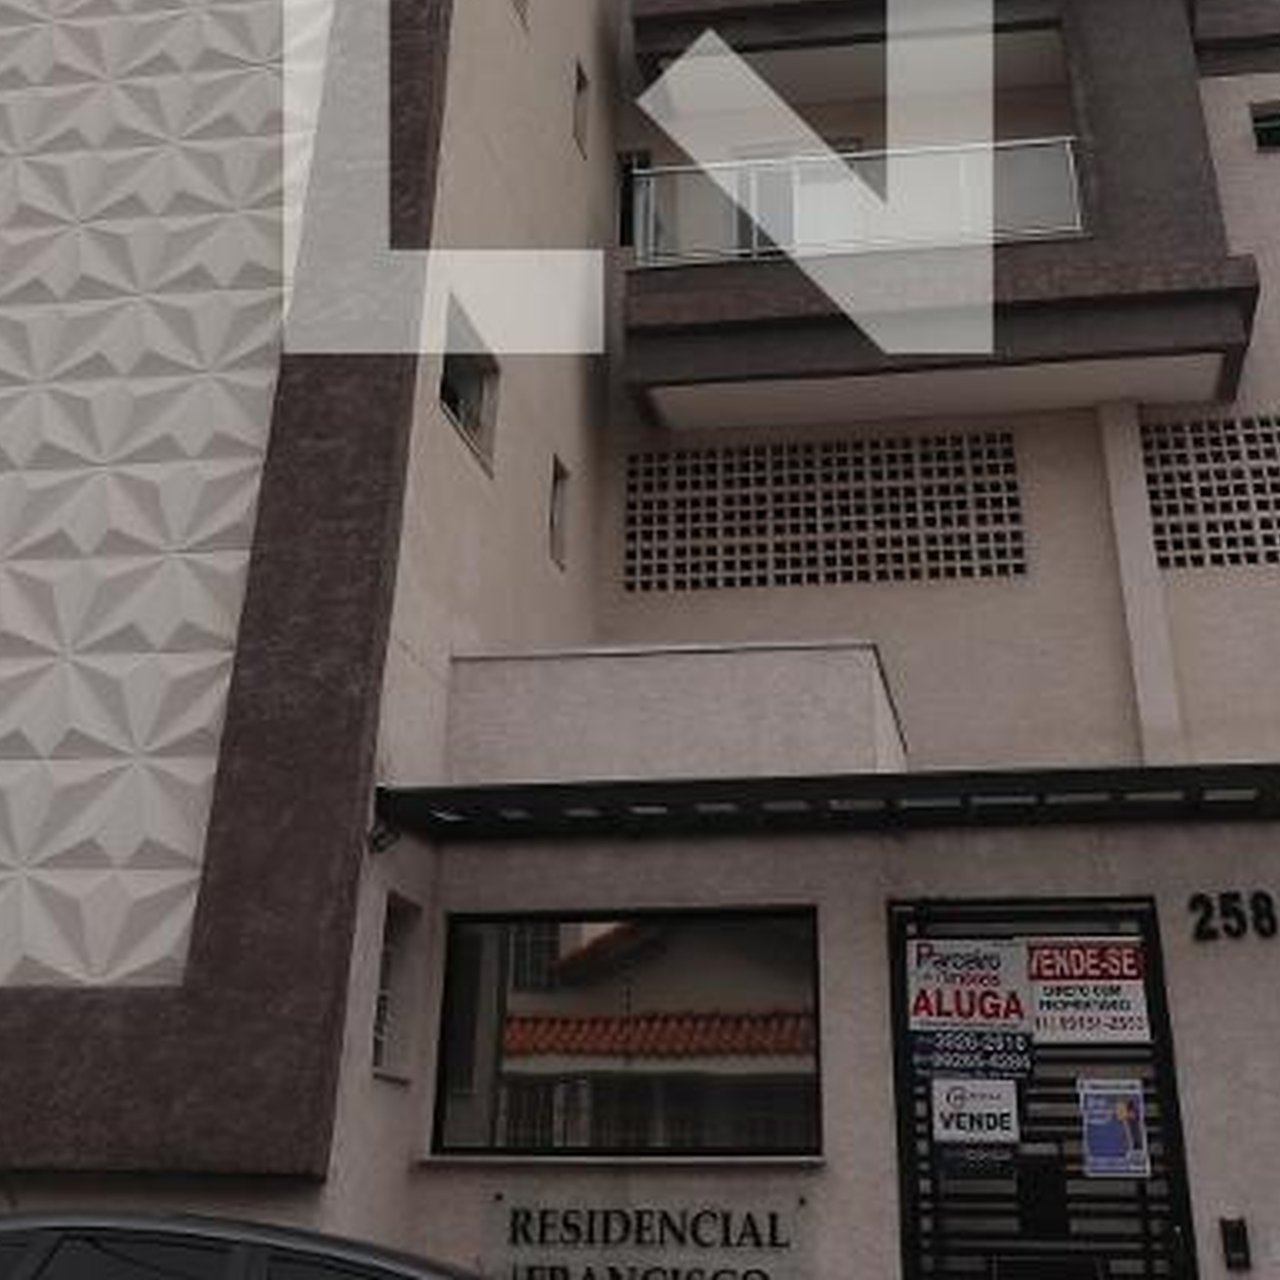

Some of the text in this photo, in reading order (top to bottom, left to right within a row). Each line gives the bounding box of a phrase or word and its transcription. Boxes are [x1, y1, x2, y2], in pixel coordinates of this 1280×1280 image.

[1188, 891, 1278, 941] 258
[913, 987, 1024, 1019] ALUGA
[939, 1112, 1011, 1131] VENDE
[508, 1206, 791, 1249] RESIDENCIAL
